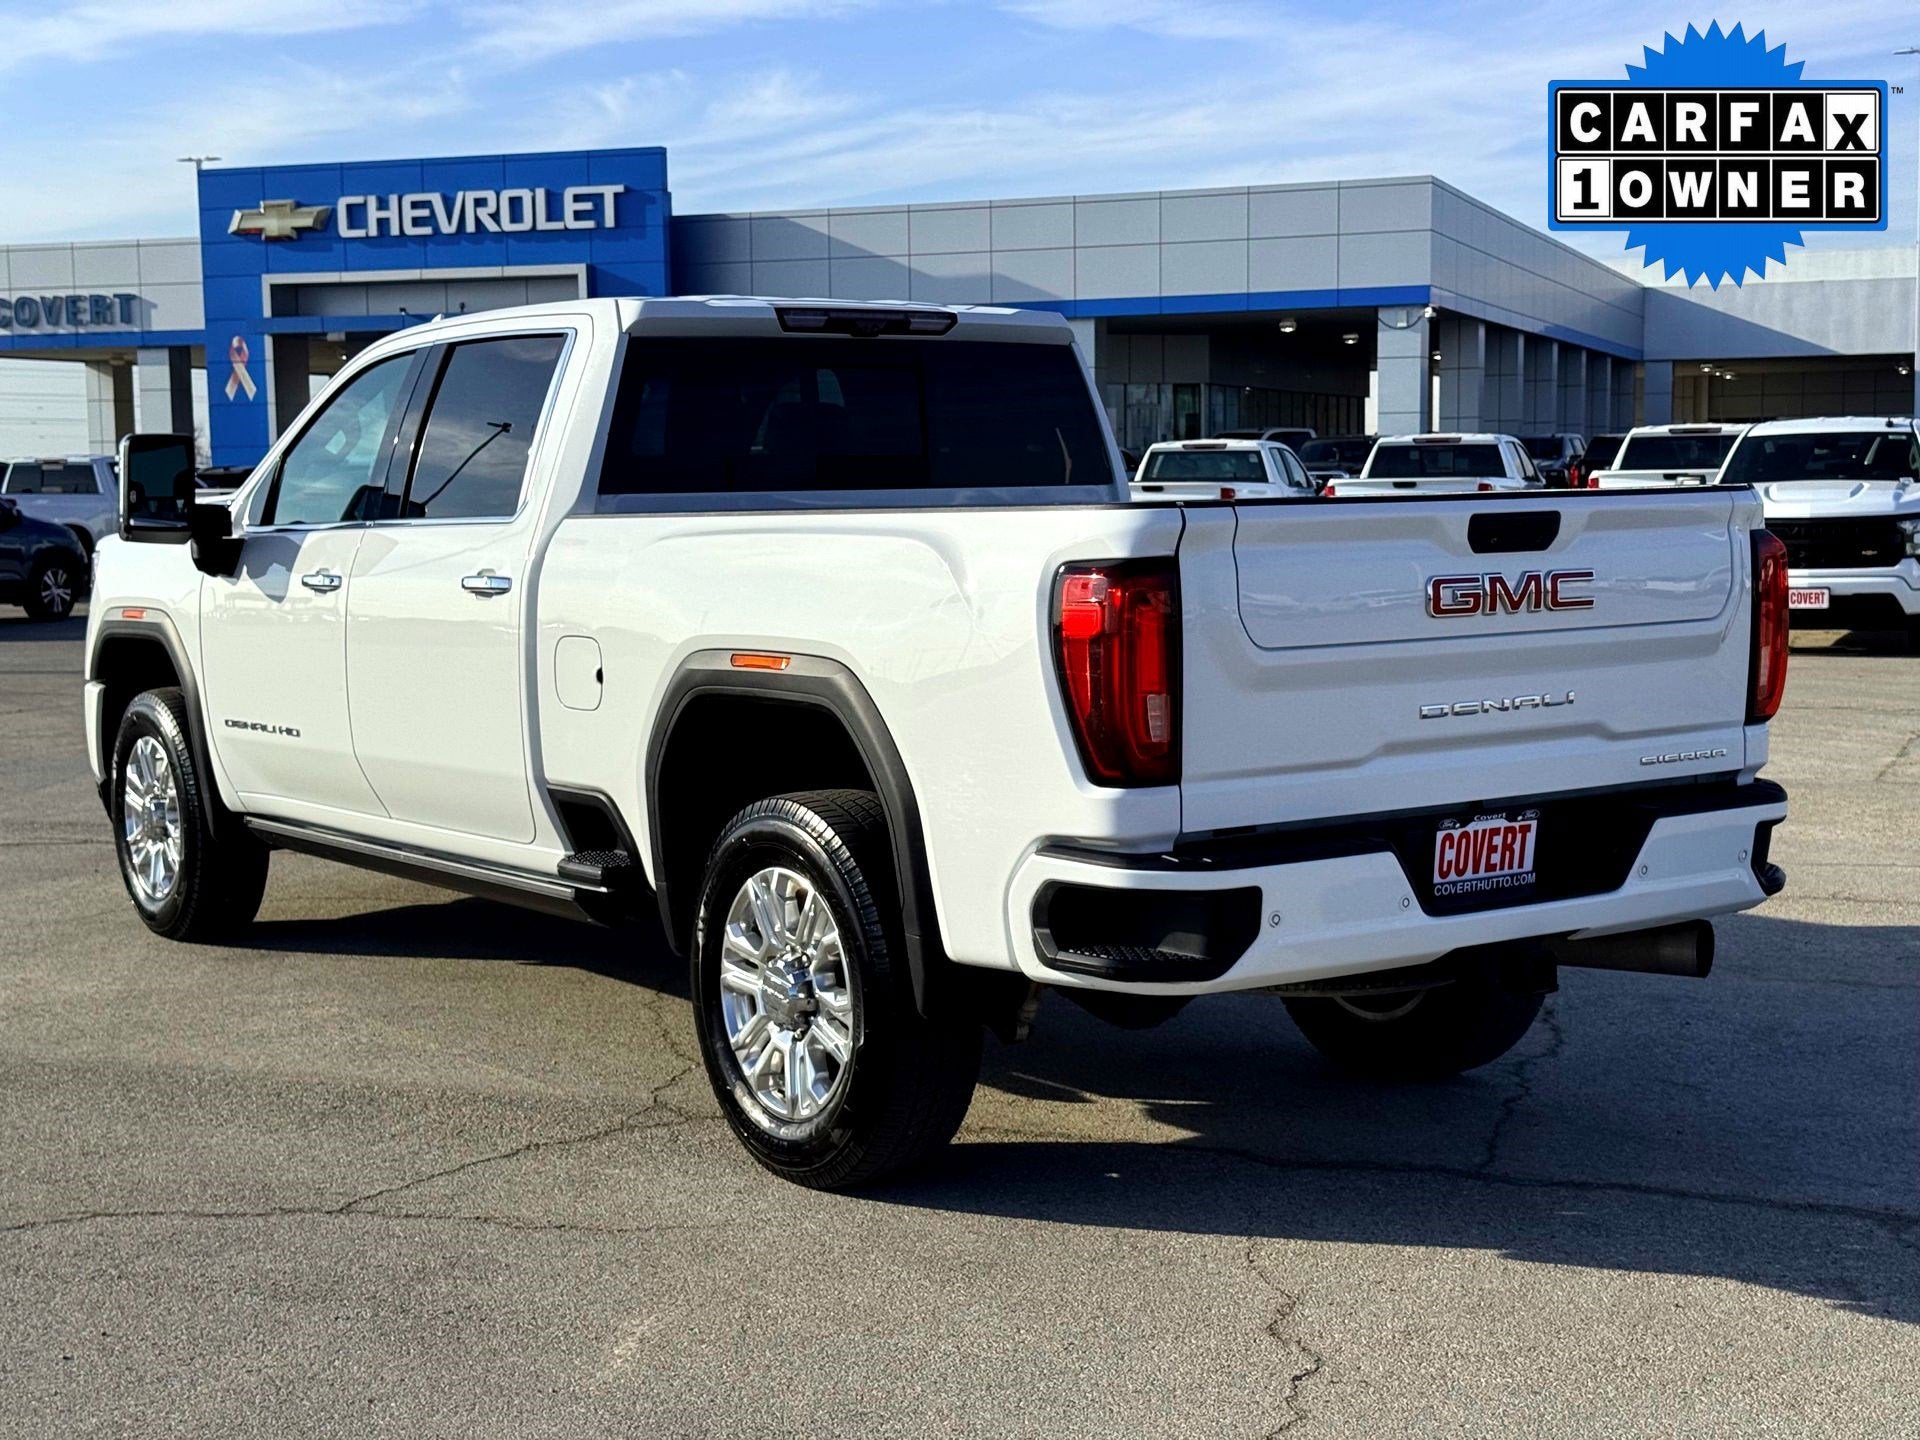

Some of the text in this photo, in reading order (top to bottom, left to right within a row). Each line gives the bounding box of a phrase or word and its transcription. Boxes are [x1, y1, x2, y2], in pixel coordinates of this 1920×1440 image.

[337, 184, 625, 238] CHEVROLET
[1425, 568, 1595, 618] GMC
[1790, 591, 1825, 605] COVERT
[1419, 690, 1576, 719] DENALI
[1640, 748, 1728, 765] SIERRA
[1474, 812, 1506, 821] Covert
[1438, 824, 1532, 880] COVERT
[1434, 872, 1536, 897] COVERTHUTTO.COM
